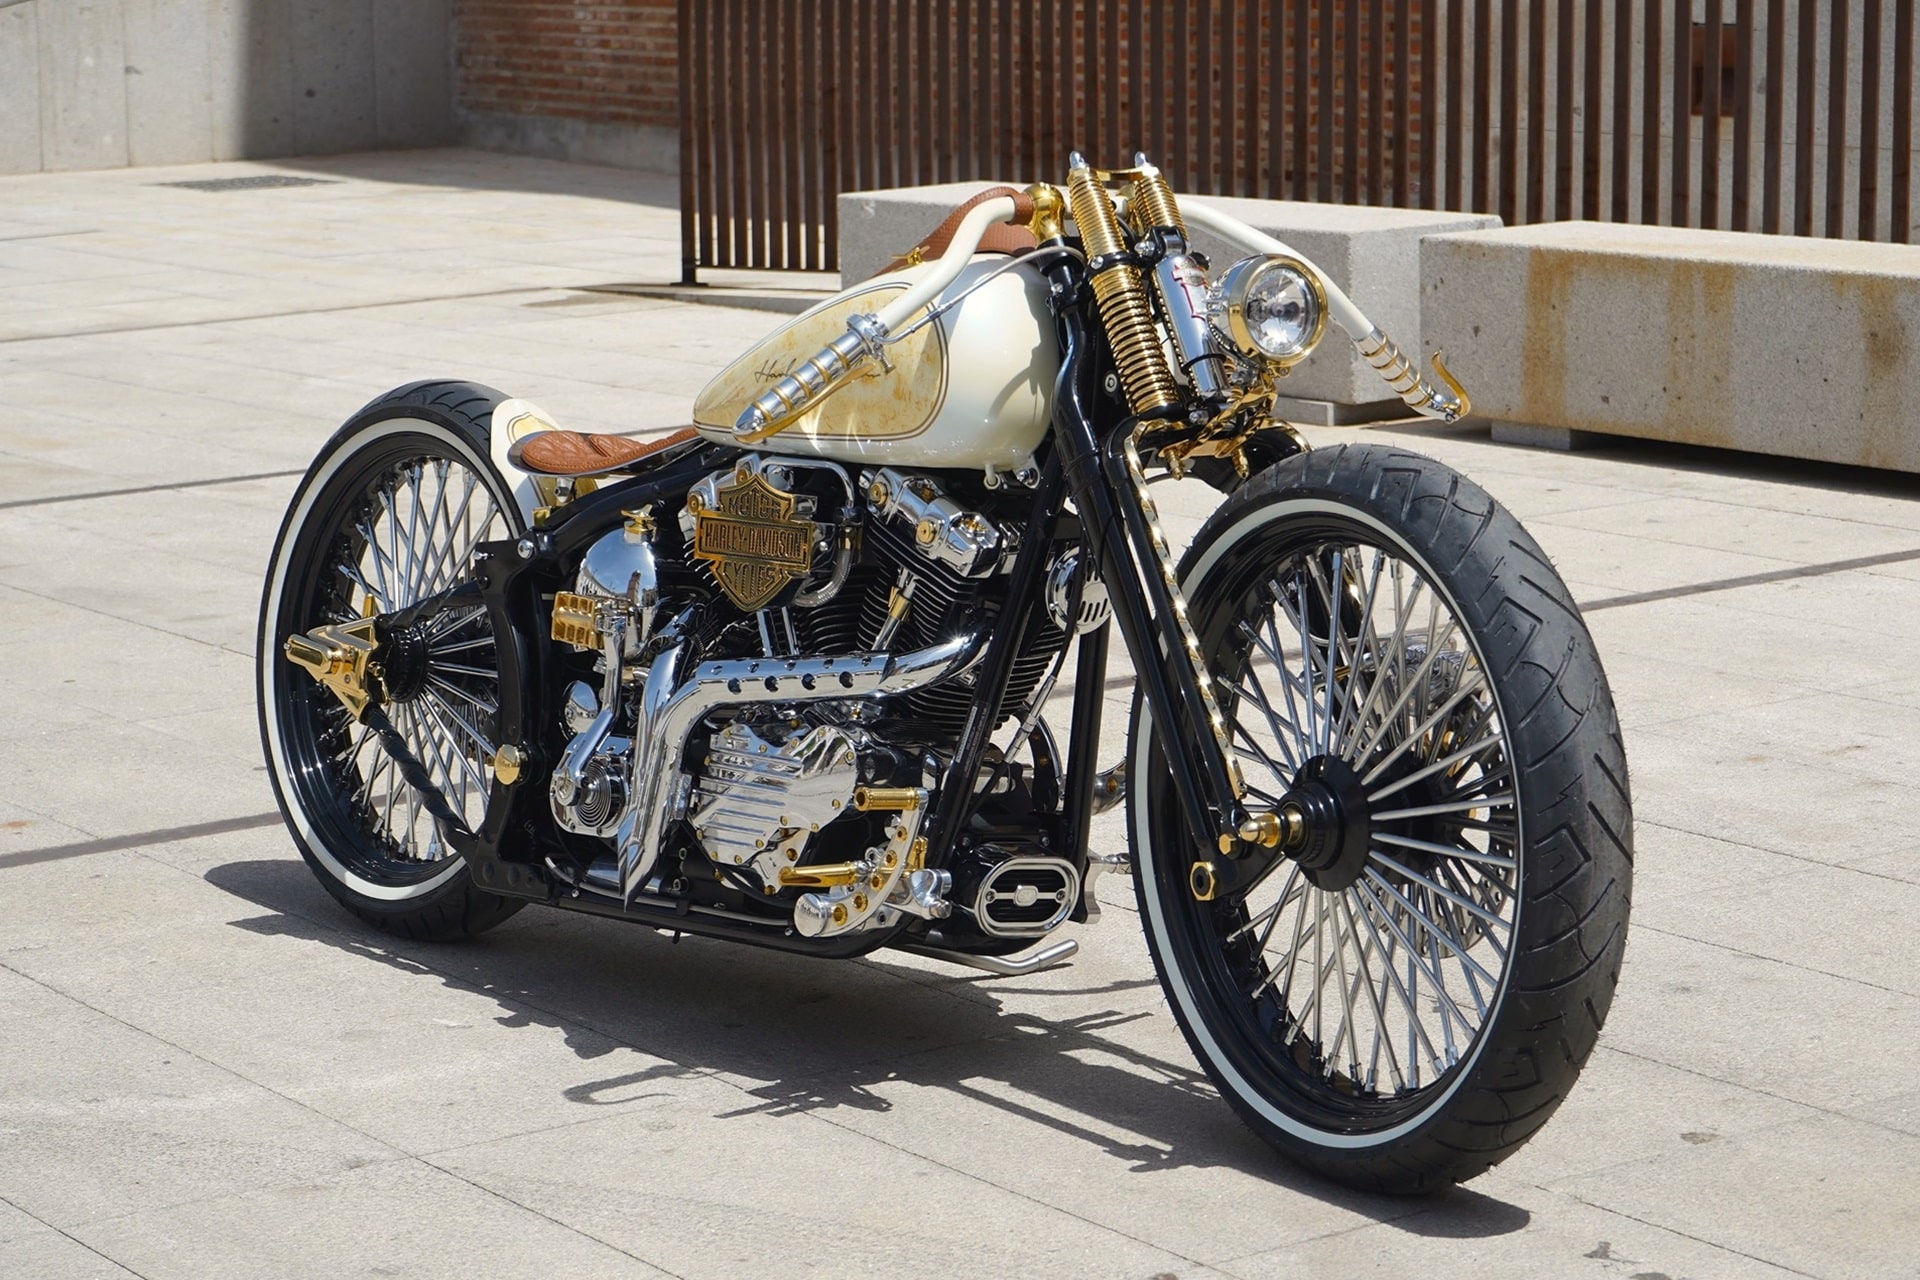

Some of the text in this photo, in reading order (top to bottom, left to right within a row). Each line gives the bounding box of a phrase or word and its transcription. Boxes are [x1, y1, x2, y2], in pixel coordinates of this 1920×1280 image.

[729, 489, 782, 520] MOTOR
[704, 521, 803, 558] HARLEY-DAVIDSON
[723, 561, 777, 600] CYCLES
